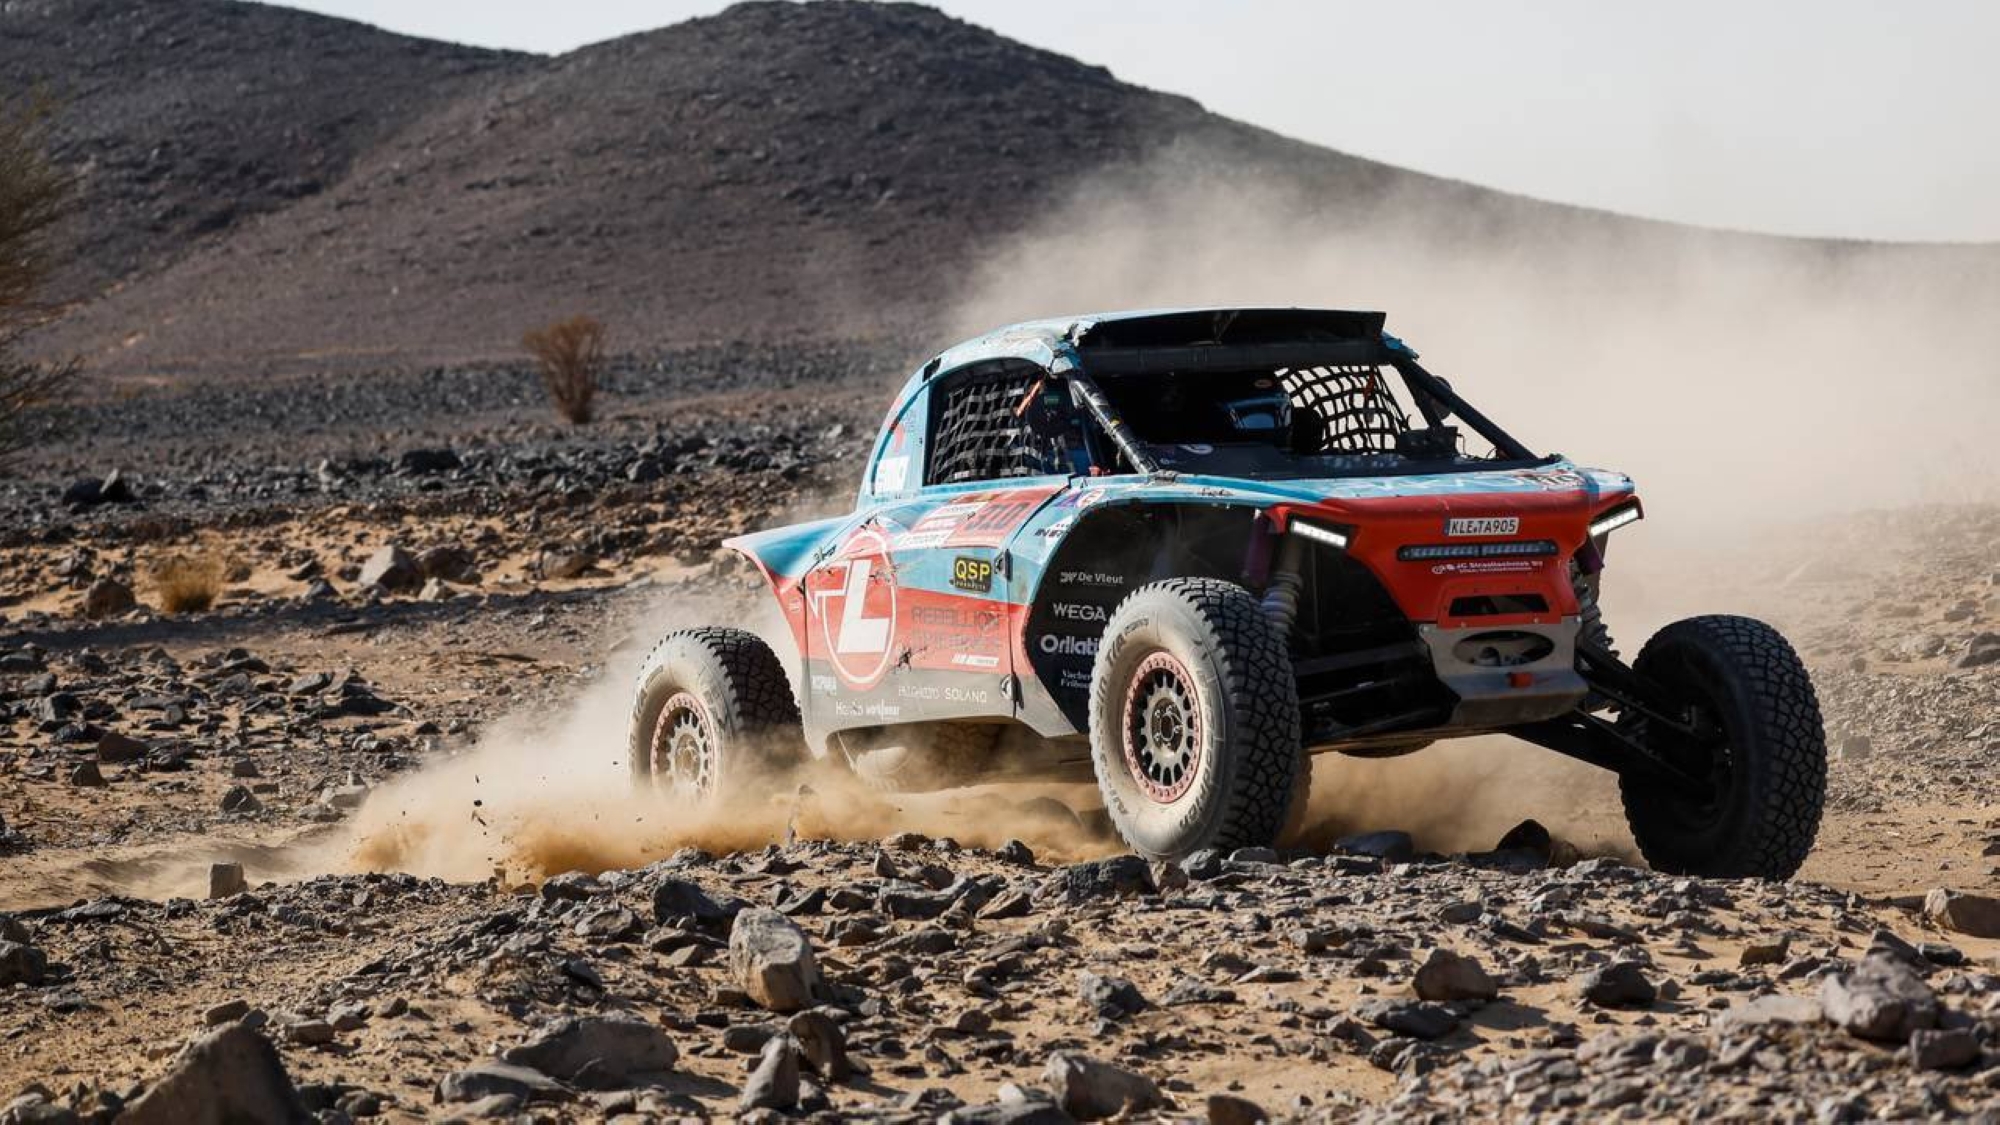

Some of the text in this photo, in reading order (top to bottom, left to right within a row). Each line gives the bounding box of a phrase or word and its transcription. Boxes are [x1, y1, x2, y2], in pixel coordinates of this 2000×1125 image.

[956, 560, 990, 581] QSP
[1078, 571, 1093, 582] De
[1052, 602, 1107, 621] WEGA
[945, 687, 988, 703] SOLANO
